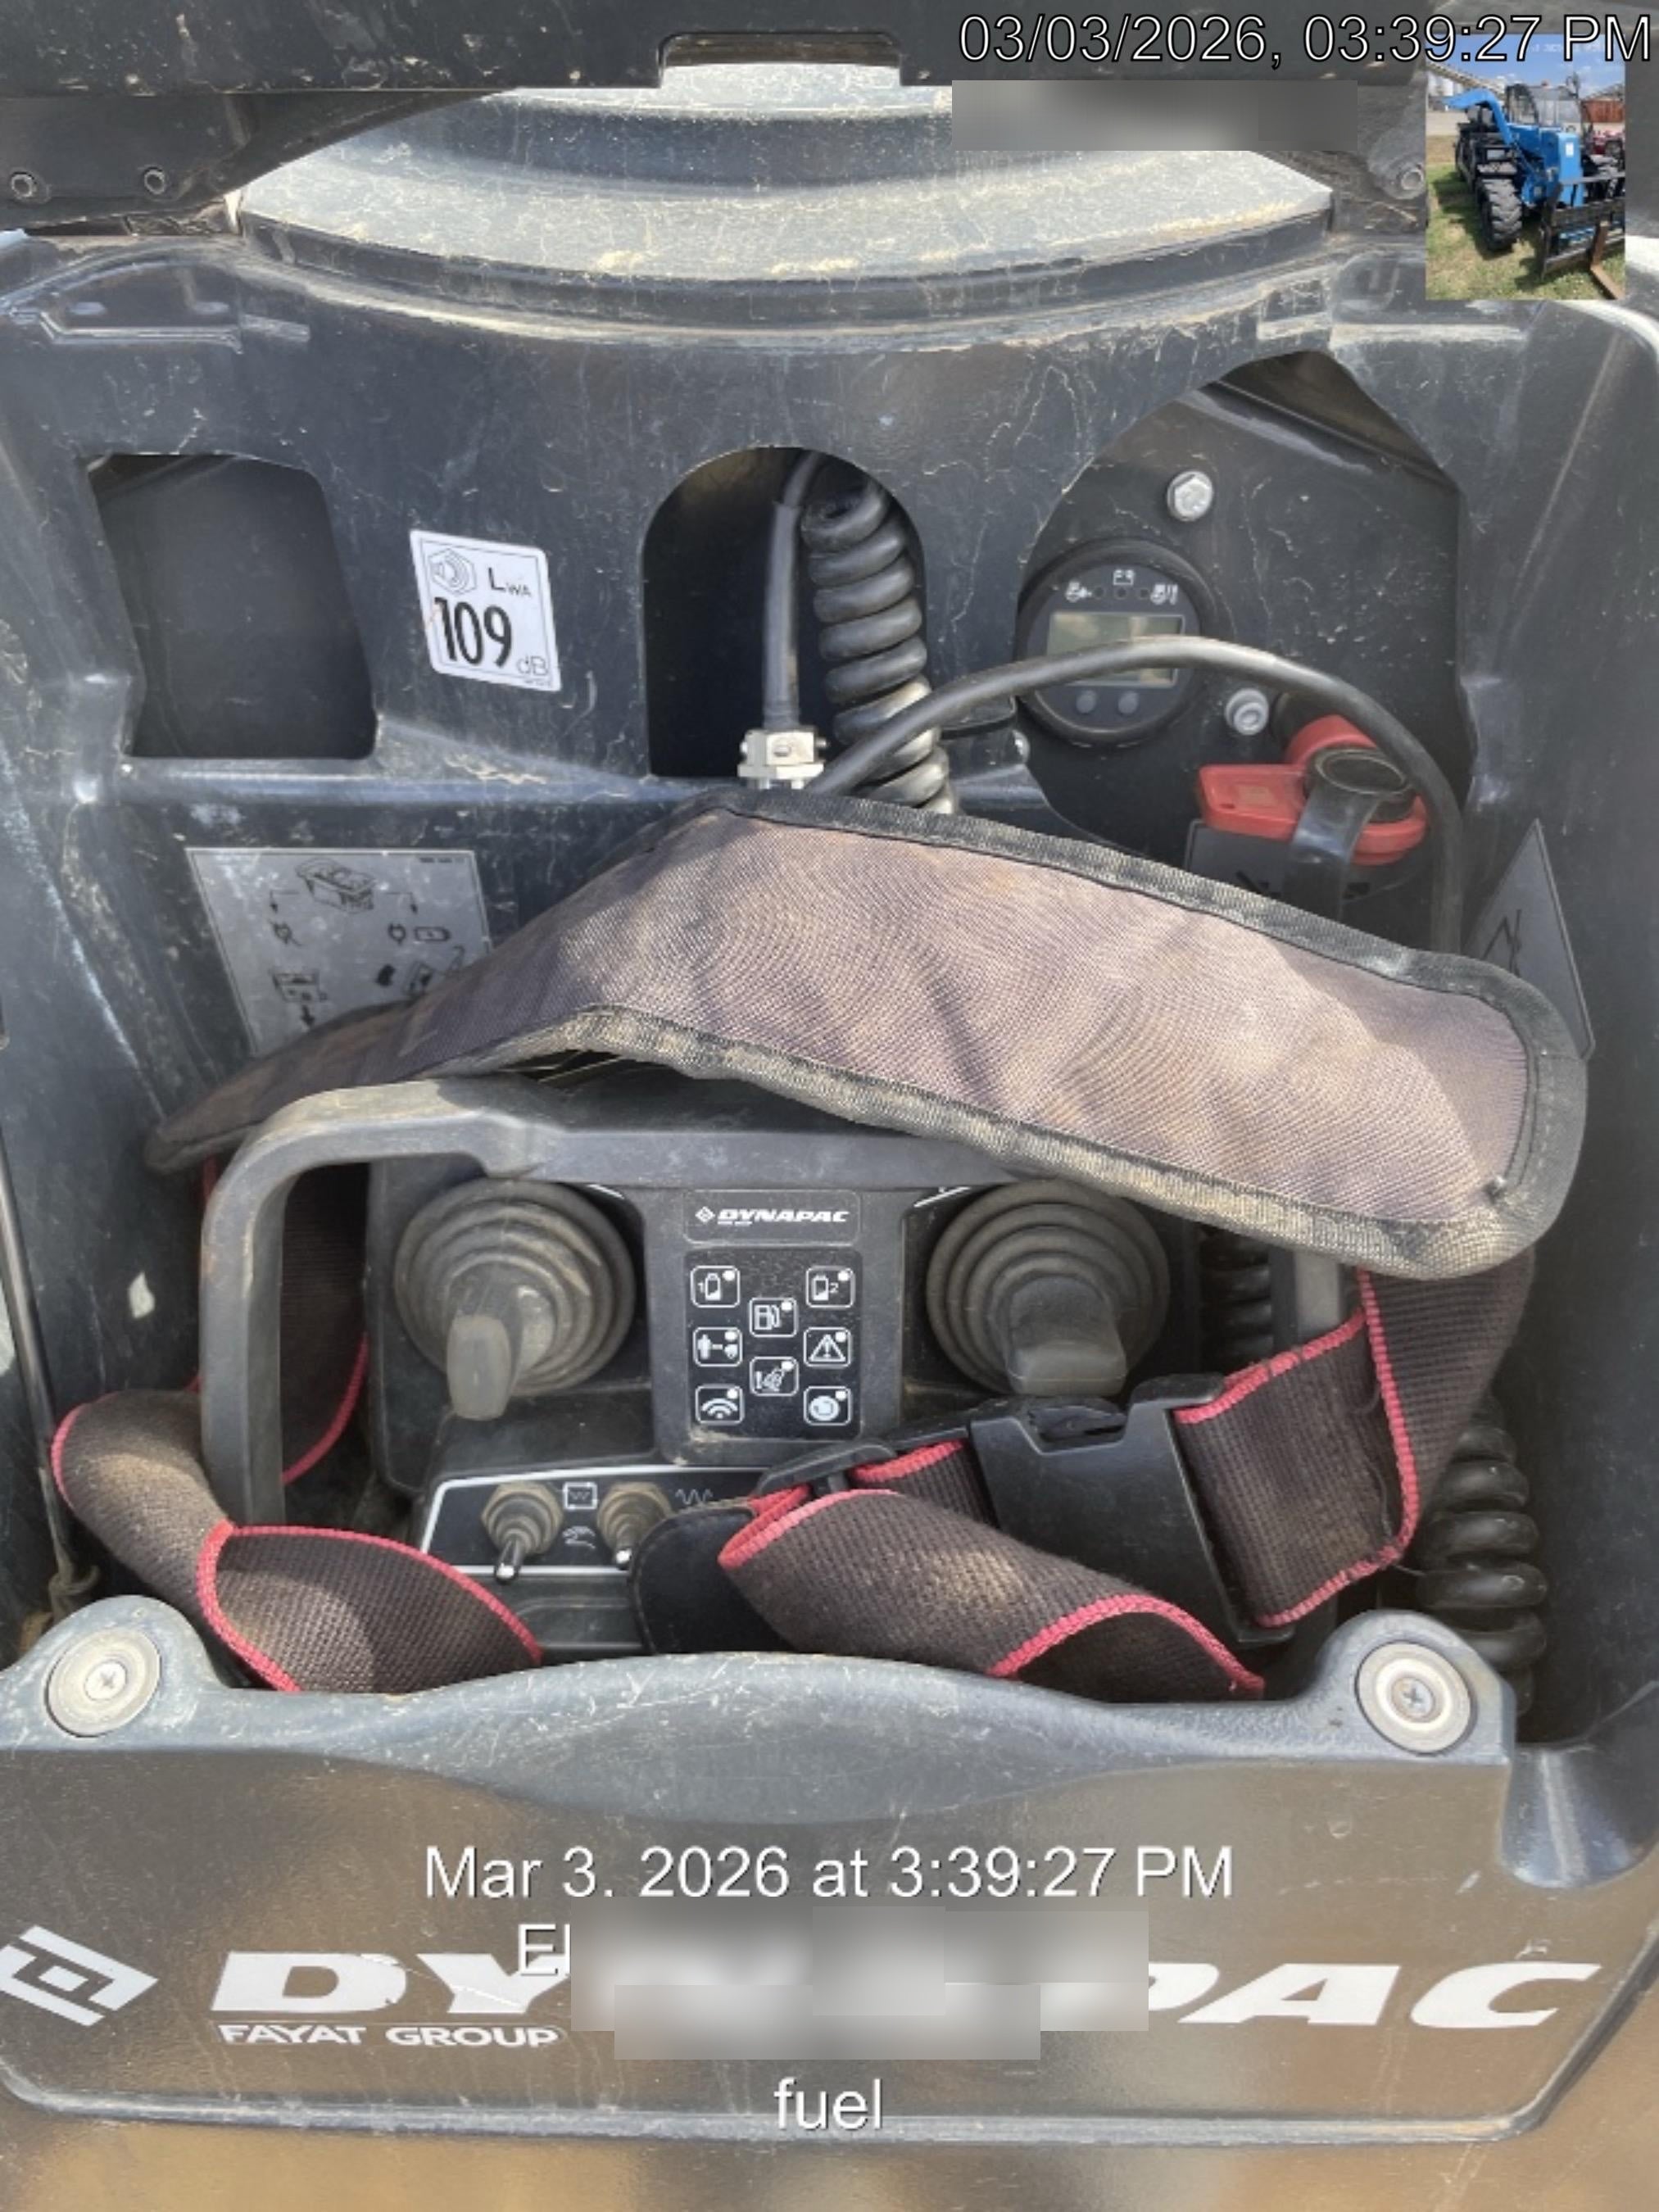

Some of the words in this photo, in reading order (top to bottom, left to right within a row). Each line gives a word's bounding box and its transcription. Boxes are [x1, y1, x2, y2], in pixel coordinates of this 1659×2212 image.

[434, 596, 512, 668] 109
[516, 655, 550, 676] dB
[717, 1208, 850, 1223] DYNAPAC
[218, 2024, 368, 2046] FAYAT
[385, 2026, 560, 2048] GROUP
